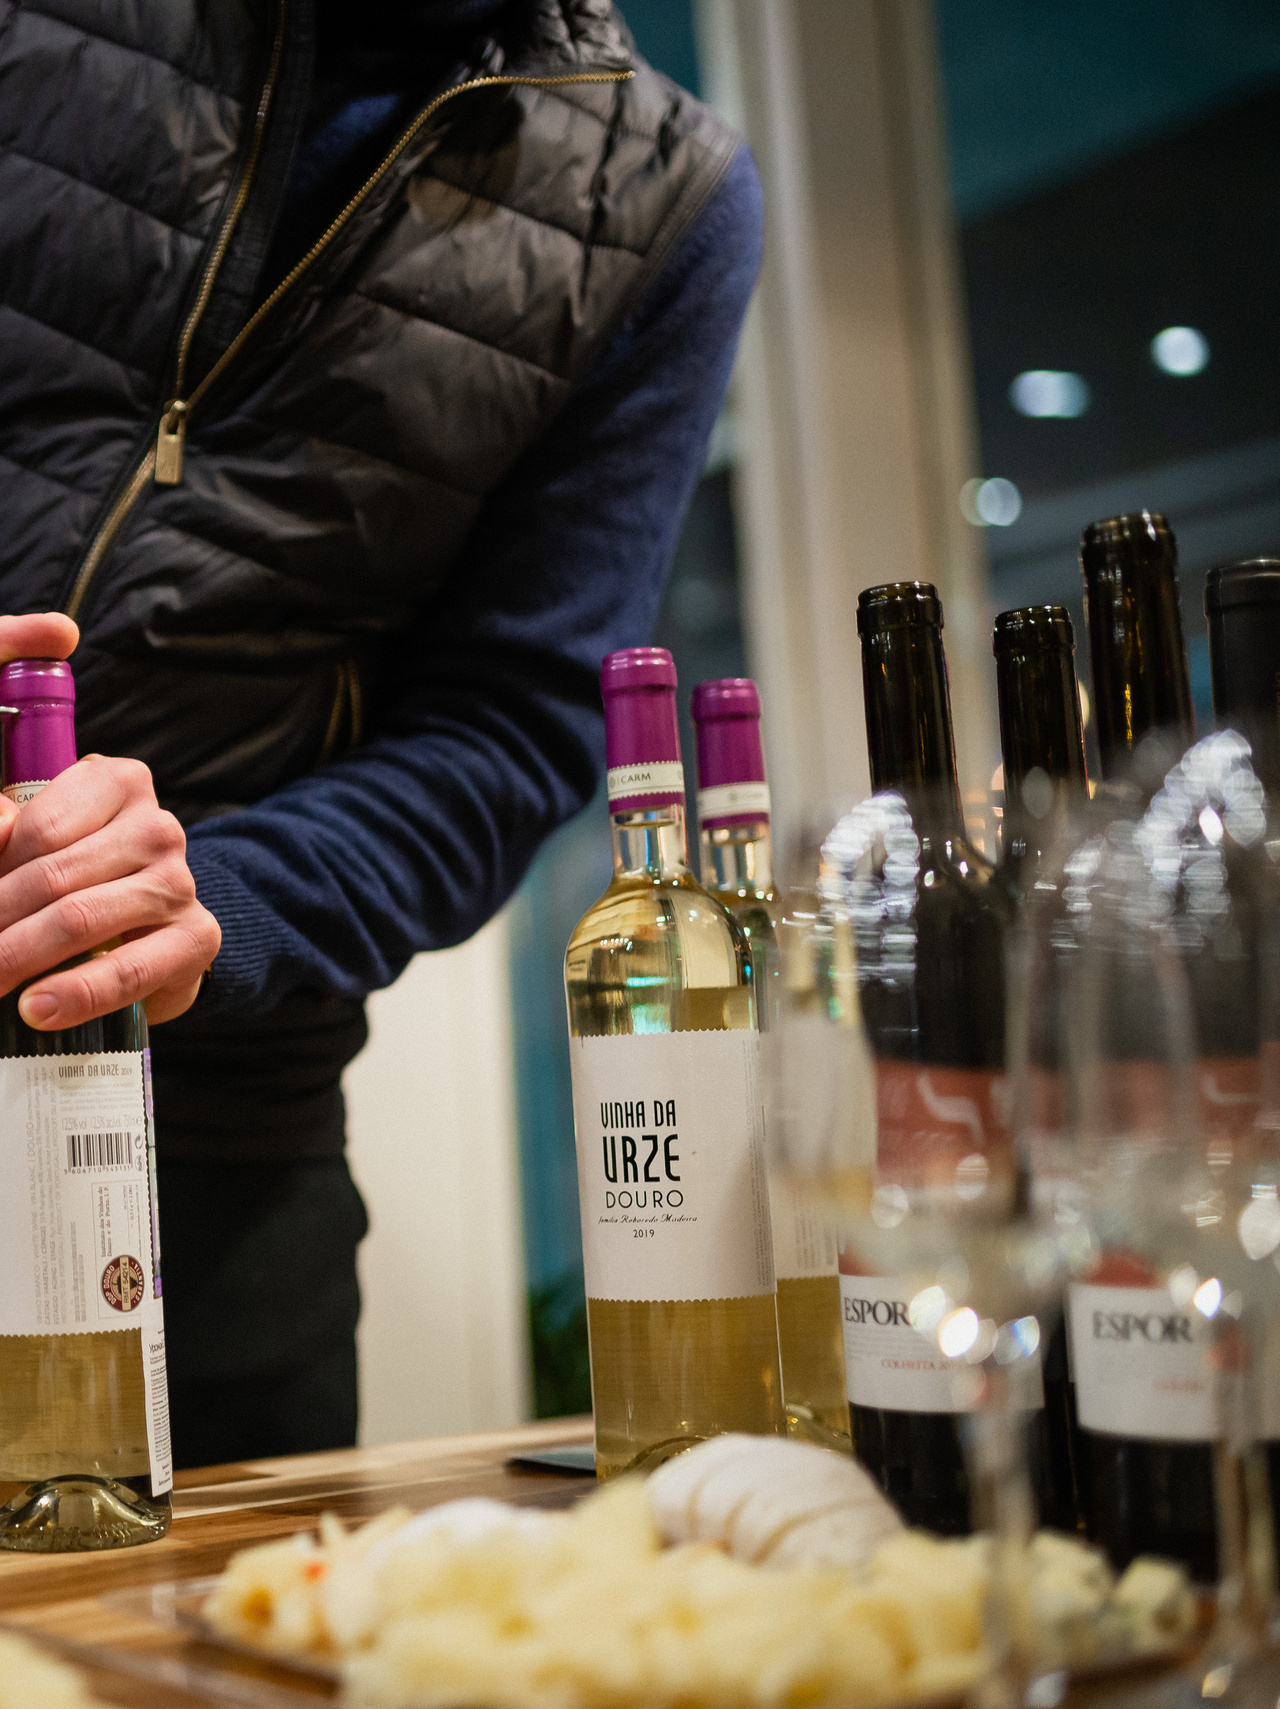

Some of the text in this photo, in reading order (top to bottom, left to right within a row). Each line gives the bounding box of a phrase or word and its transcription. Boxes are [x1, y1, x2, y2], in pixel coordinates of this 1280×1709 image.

[621, 772, 651, 784] CARM
[17, 793, 38, 804] CAR
[58, 1065, 85, 1078] VINHA
[87, 1064, 99, 1077] DA
[100, 1063, 119, 1077] URZE
[600, 1100, 677, 1129] VINHA DA
[26, 1123, 35, 1157] DOURO
[602, 1134, 681, 1183] URZE
[606, 1189, 684, 1209] DOURO
[660, 1213, 698, 1224] Madeira
[633, 1229, 655, 1238] 2019
[103, 1265, 115, 1289] DOURO
[844, 1297, 911, 1326] ESPOR
[1092, 1310, 1193, 1344] ESPOR
